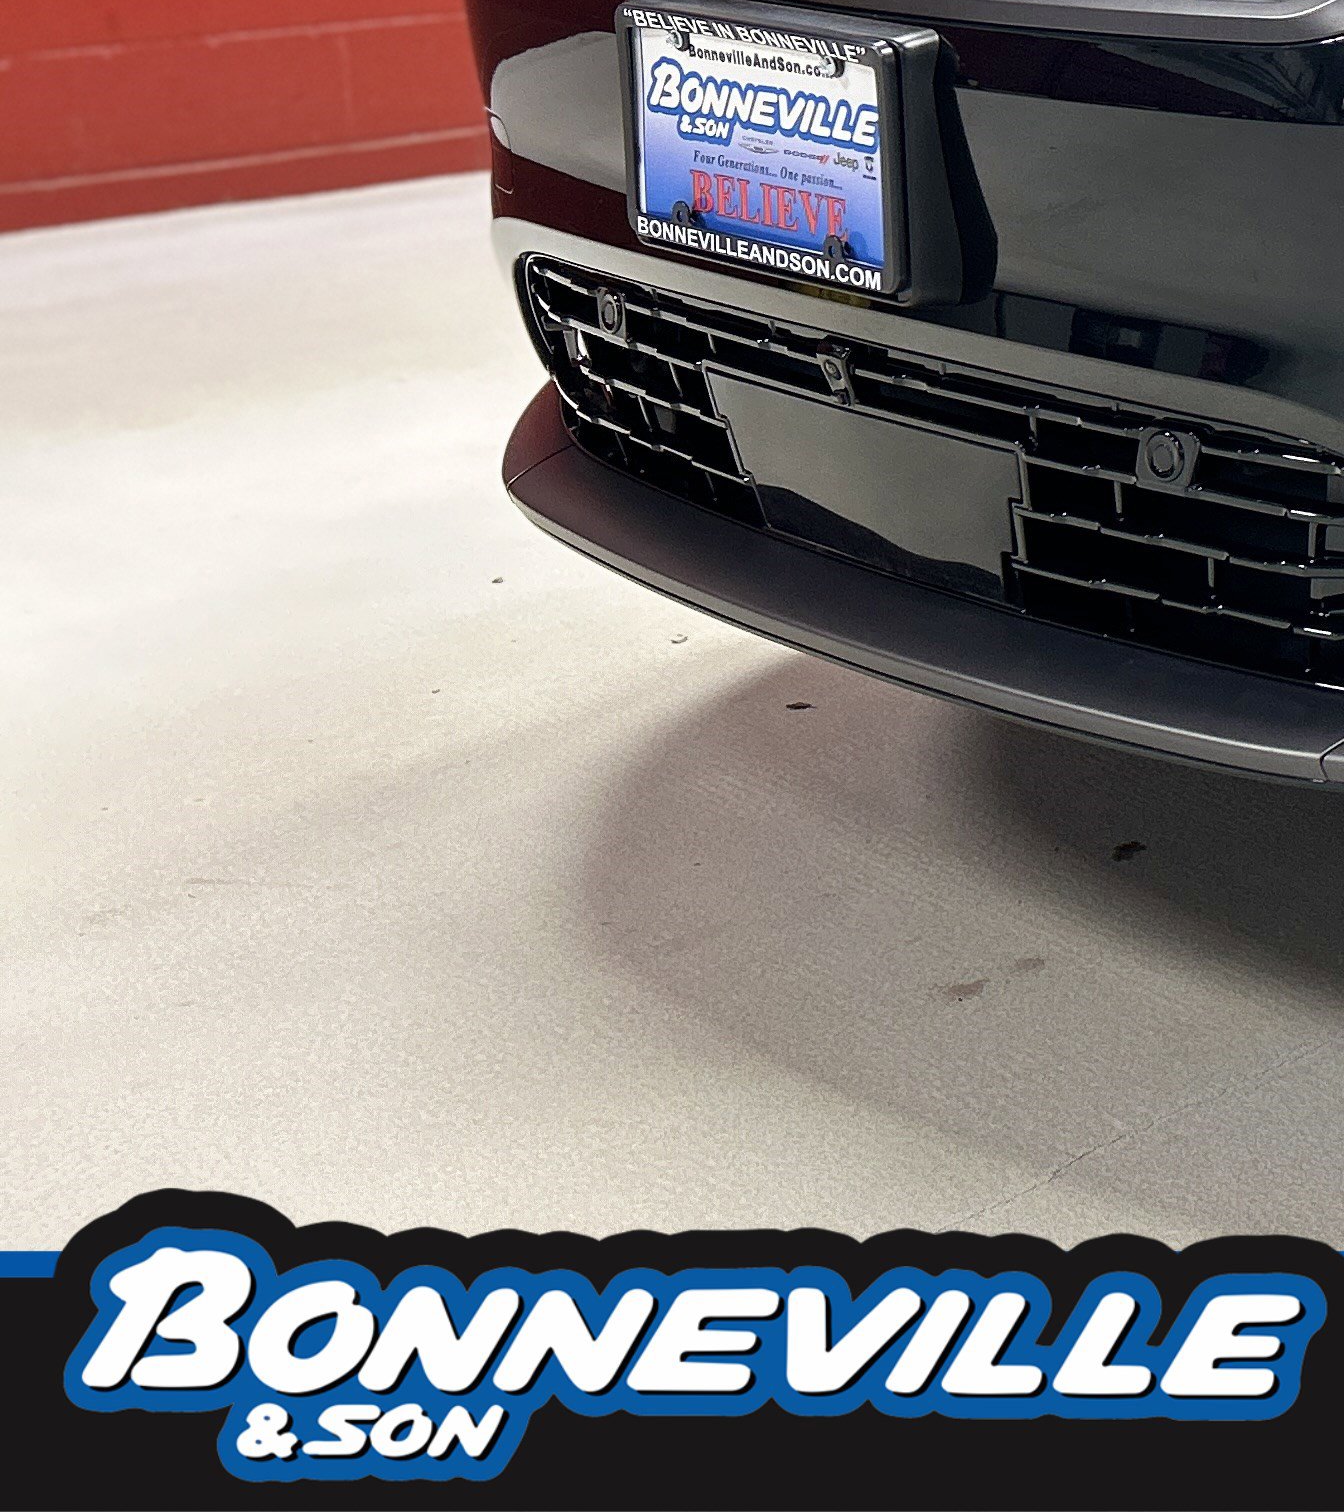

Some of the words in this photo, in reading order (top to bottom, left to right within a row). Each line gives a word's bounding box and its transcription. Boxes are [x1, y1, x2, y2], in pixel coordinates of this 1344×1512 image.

[711, 21, 734, 40] IN
[650, 61, 879, 146] BONNEVILLE
[693, 149, 716, 166] Four
[780, 166, 799, 182] One
[833, 151, 859, 172] Jeep
[690, 169, 848, 242] BELIEVE
[637, 216, 882, 291] BONNEVILLEANDSON.COM
